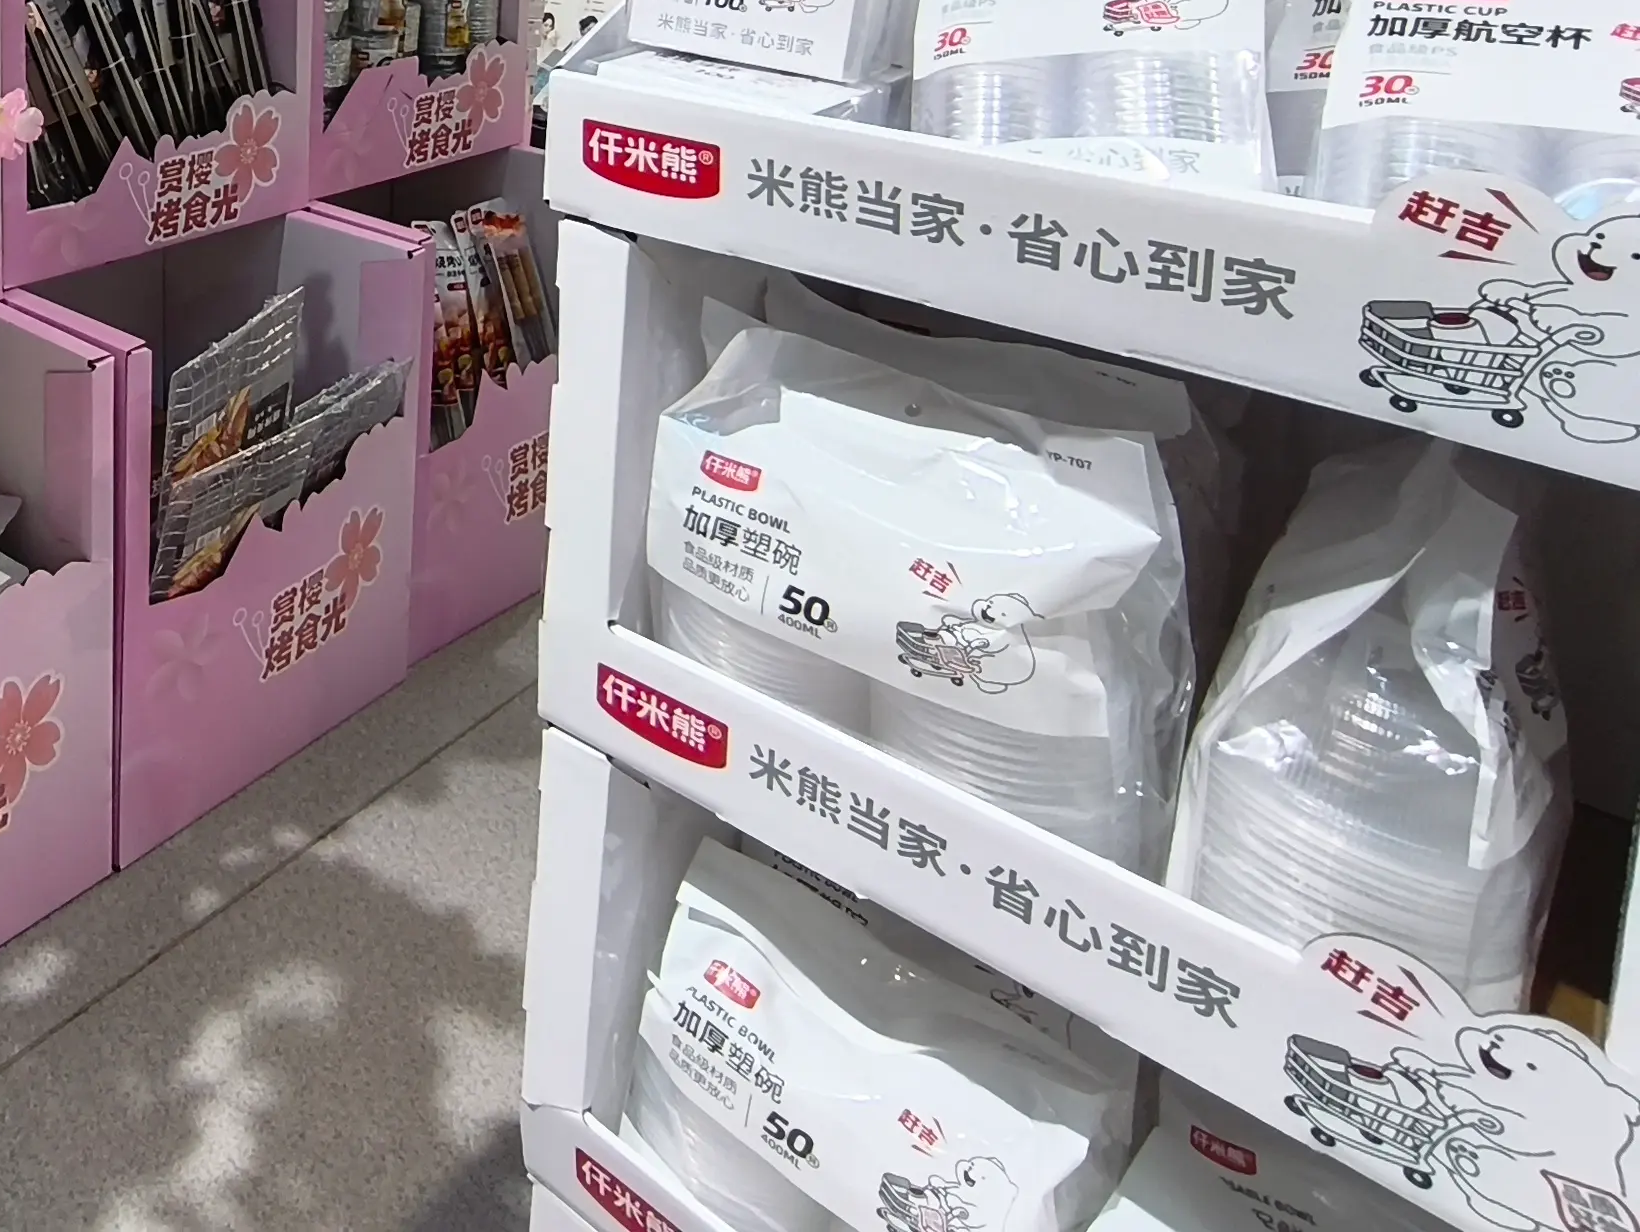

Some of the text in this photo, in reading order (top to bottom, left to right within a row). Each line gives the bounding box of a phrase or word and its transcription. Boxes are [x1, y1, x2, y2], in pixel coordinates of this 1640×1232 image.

[1367, 14, 1593, 51] 加厚航空杯
[1373, 0, 1509, 18] PLASTIC CUP
[934, 27, 967, 53] 30
[414, 88, 457, 129] 赏樱
[1359, 74, 1414, 98] 30
[405, 119, 473, 167] 烤食光
[156, 151, 216, 199] 赏樱
[147, 183, 240, 245] 烤食光
[1397, 190, 1512, 252] 赶吉
[691, 485, 792, 536] PLASTIC BOWL
[682, 503, 803, 576] 加厚塑碗
[683, 539, 755, 585] 食品级材质
[682, 556, 750, 603] 品质更放心
[909, 556, 954, 596] 赶吉
[271, 569, 325, 634] 赏樱
[778, 584, 831, 627] 50
[262, 593, 348, 680] 烤食光
[777, 613, 822, 640] 400ML
[1320, 947, 1421, 1023] 赶吉
[672, 1000, 786, 1106] 加厚塑碗
[737, 1024, 777, 1065] BOWL
[760, 1132, 803, 1172] 400ML
[762, 1109, 815, 1160] 50
